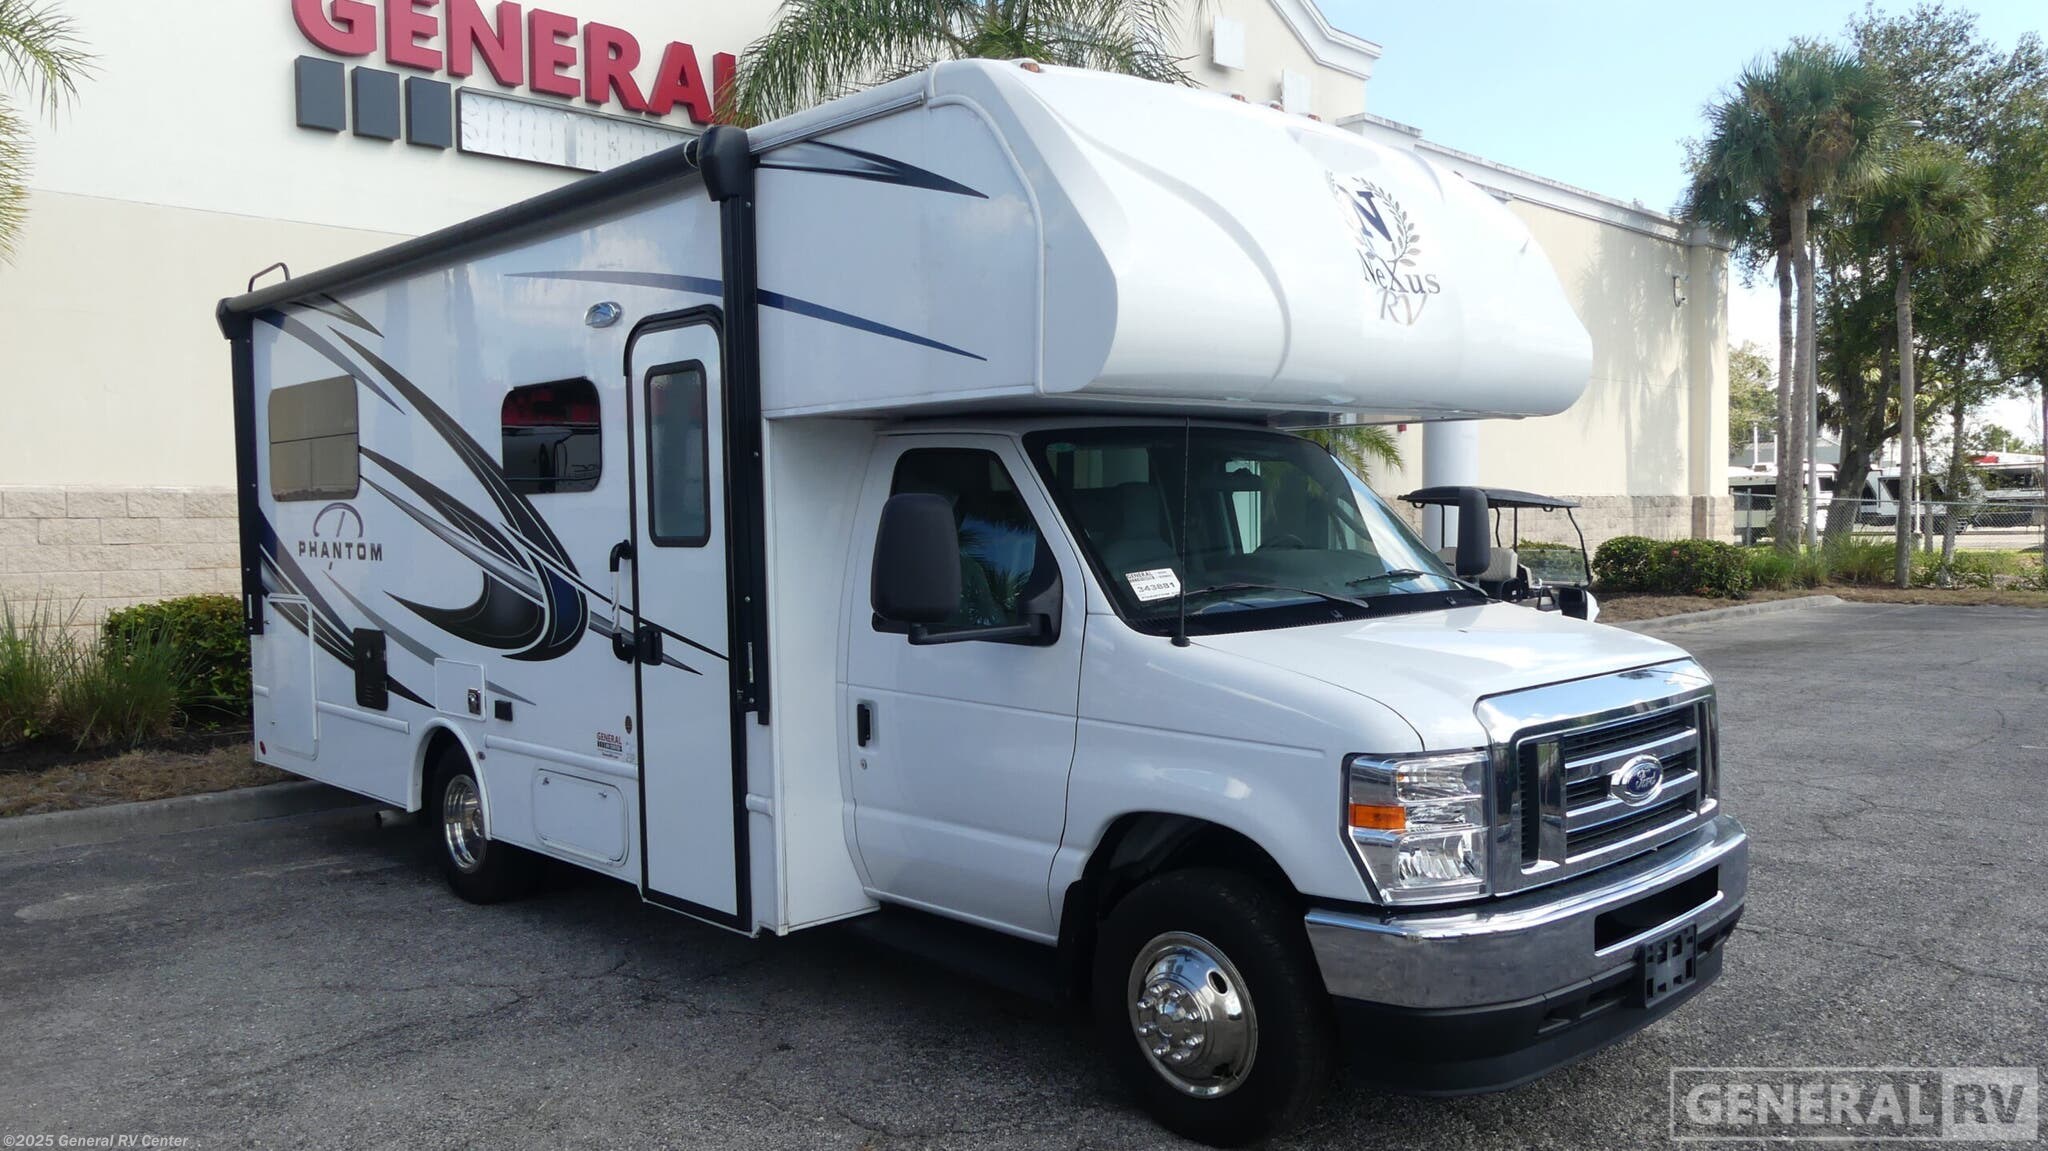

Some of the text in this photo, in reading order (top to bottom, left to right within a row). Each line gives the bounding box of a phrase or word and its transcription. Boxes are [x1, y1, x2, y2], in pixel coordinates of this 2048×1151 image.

[1376, 288, 1428, 326] RV
[298, 541, 383, 561] PHANTOM
[596, 731, 622, 745] GENERAL
